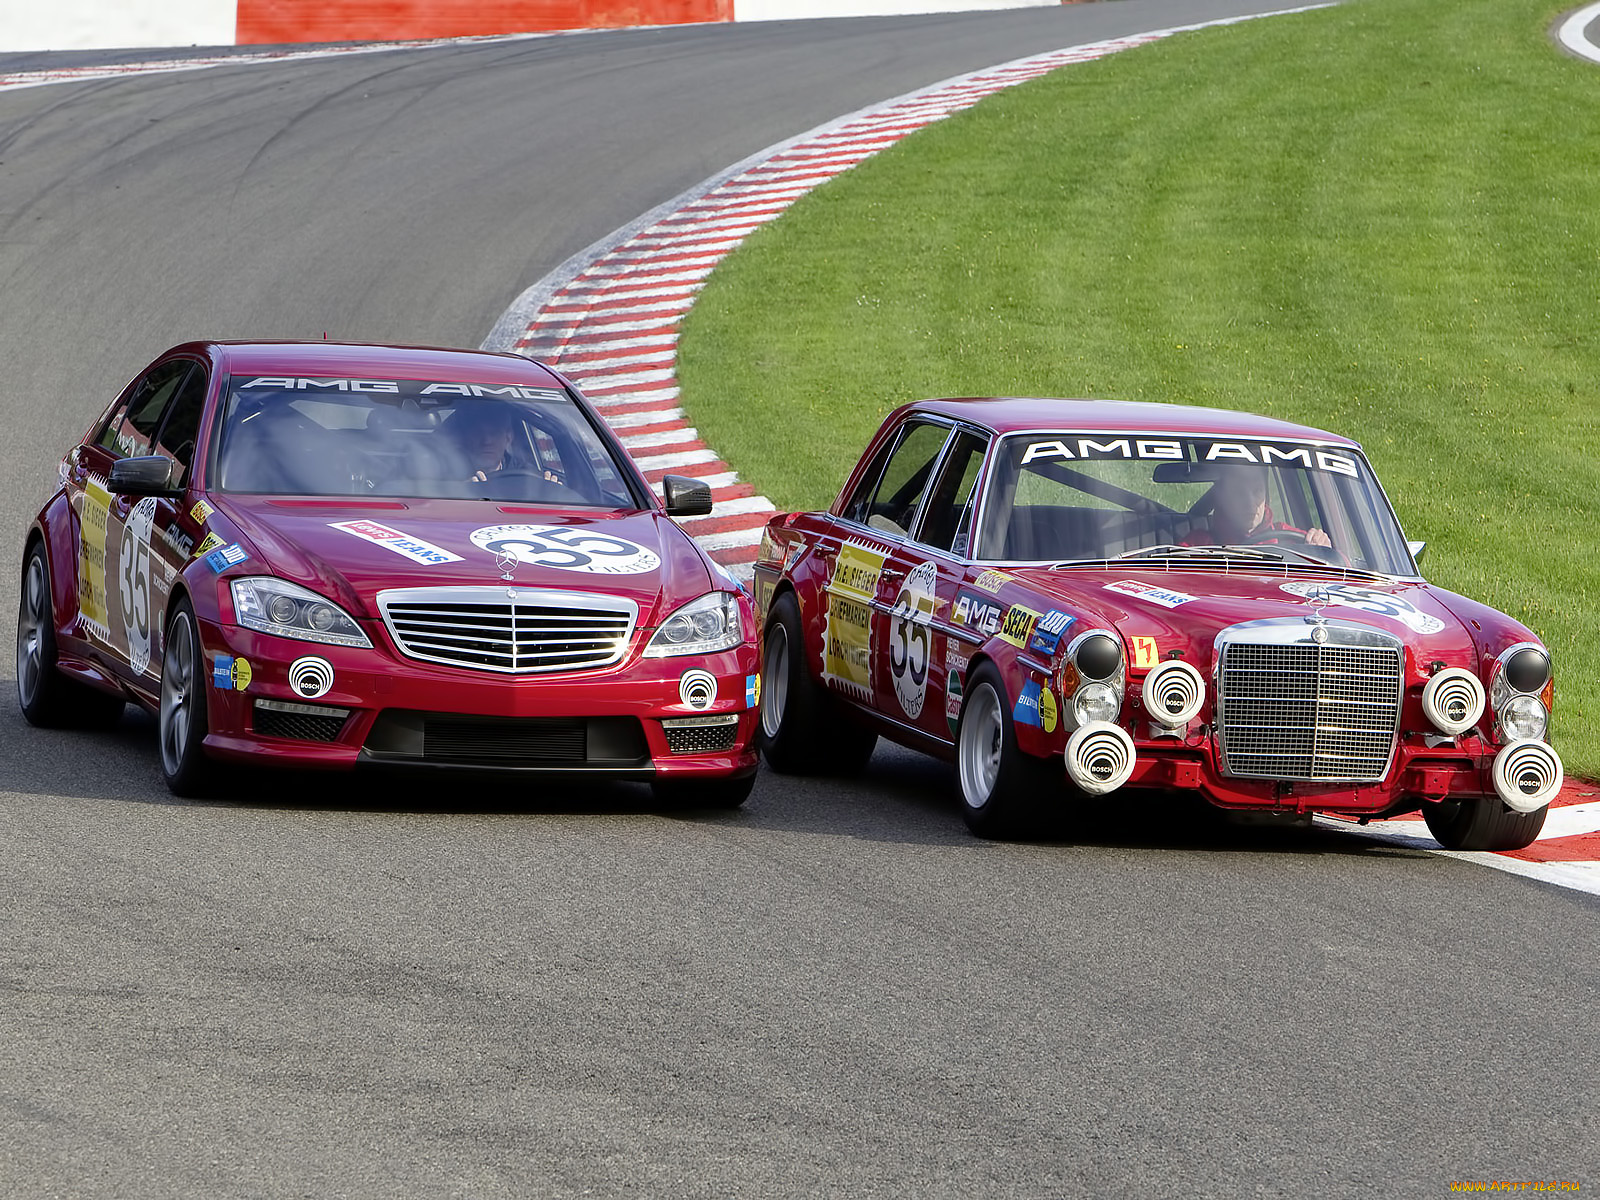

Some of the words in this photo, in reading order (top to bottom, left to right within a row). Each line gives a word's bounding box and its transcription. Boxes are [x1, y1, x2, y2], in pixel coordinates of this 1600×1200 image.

[240, 377, 399, 393] AMG
[419, 383, 567, 401] AMG
[1021, 440, 1183, 465] AMG
[1205, 442, 1358, 478] AMG
[163, 523, 193, 560] AMG
[387, 539, 449, 562] JEANS
[485, 528, 640, 567] 35
[120, 525, 151, 640] 35
[850, 567, 876, 593] SIEGER
[1144, 590, 1188, 603] JEANS
[954, 596, 1001, 634] AMG
[1003, 607, 1032, 642] SECA
[1037, 610, 1072, 635] 100
[890, 589, 934, 686] 35
[896, 681, 923, 715] FILTERS
[1091, 765, 1112, 774] BOSCH
